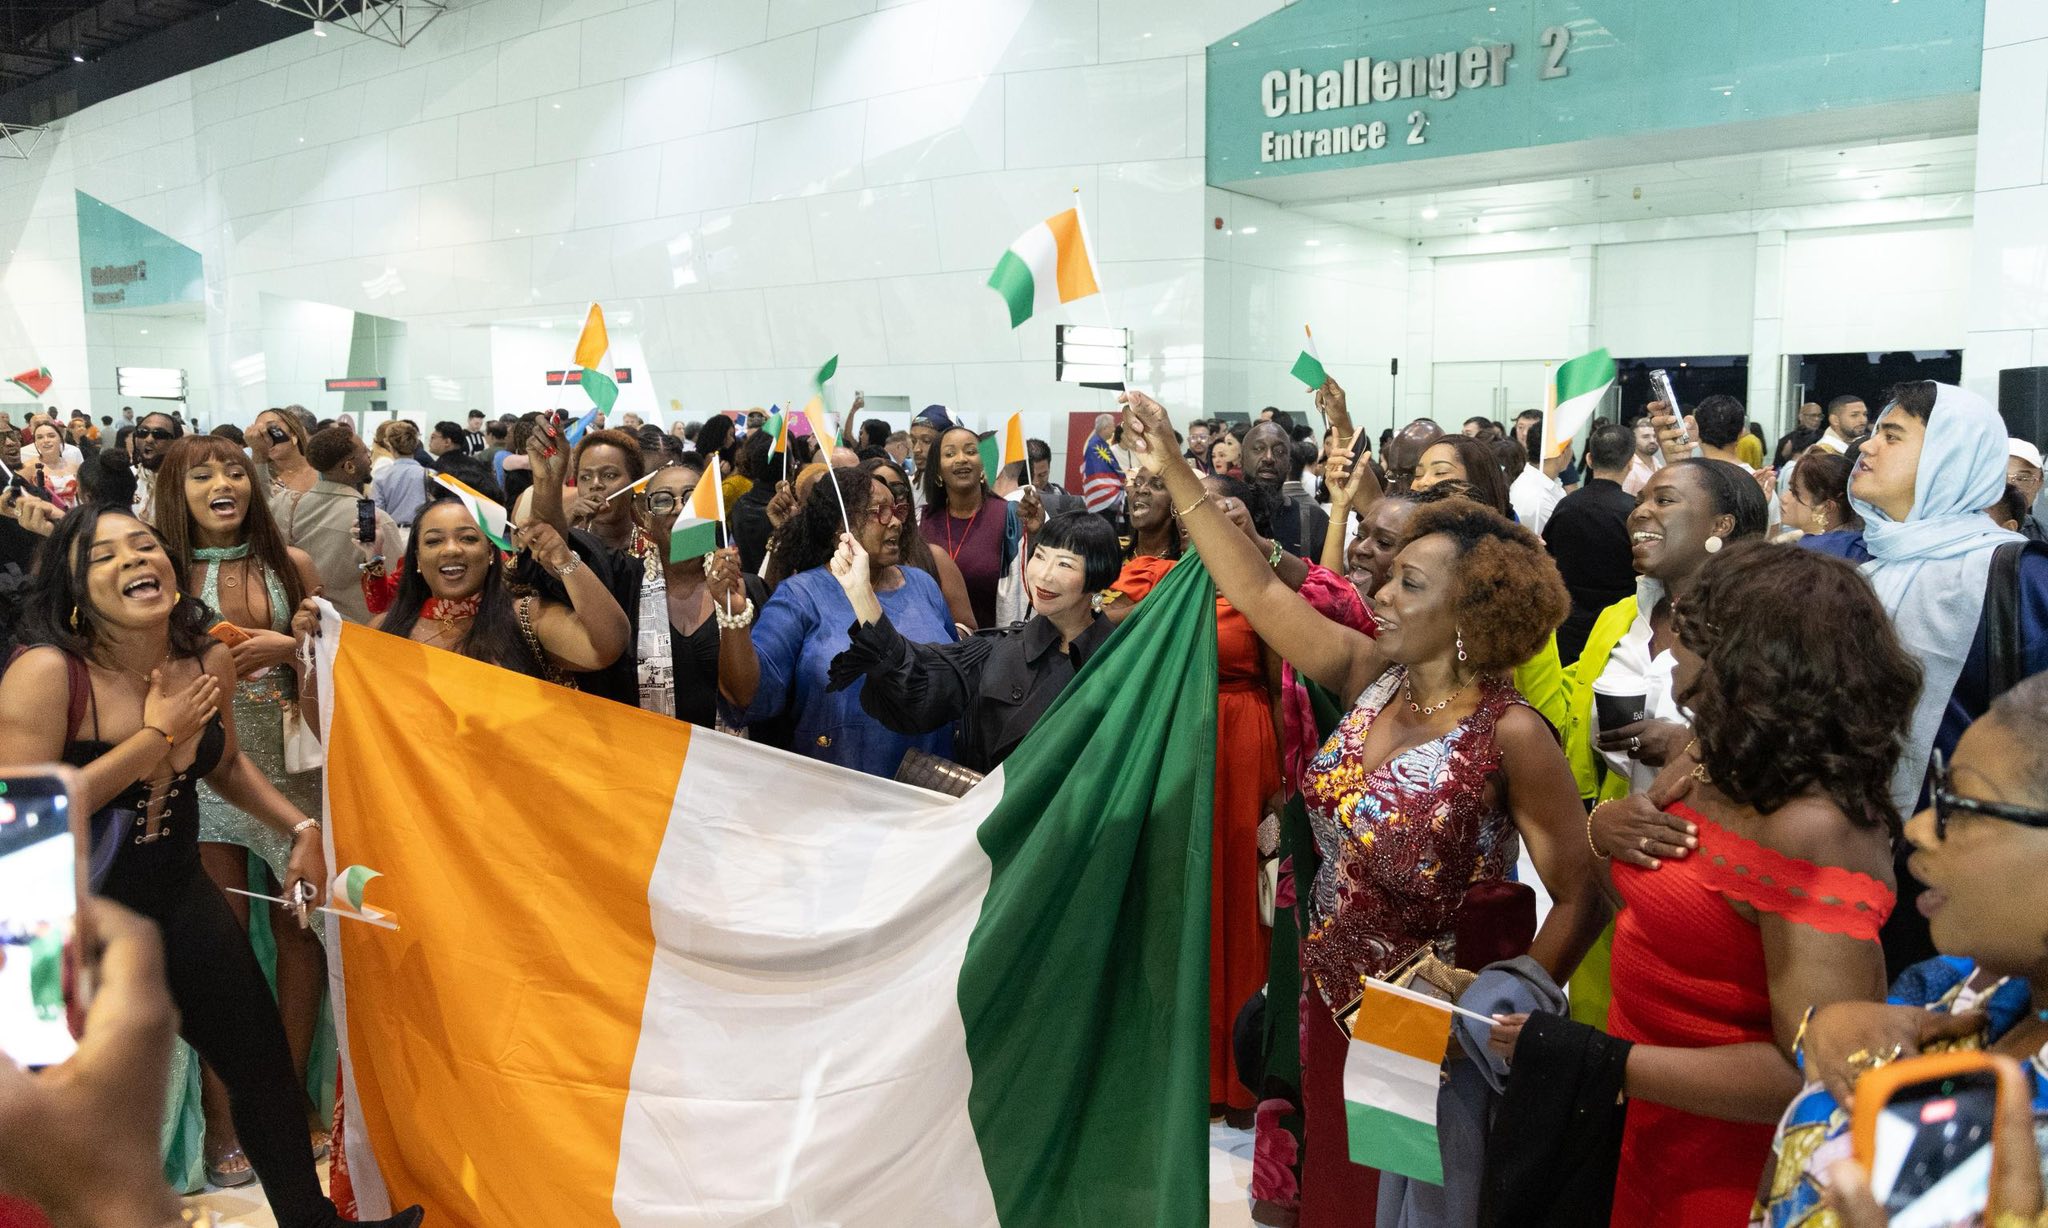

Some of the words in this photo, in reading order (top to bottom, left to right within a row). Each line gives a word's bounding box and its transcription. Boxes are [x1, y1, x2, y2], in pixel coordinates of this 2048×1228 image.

[1261, 43, 1514, 118] Challenger
[1540, 25, 1571, 80] 2
[1261, 120, 1387, 162] Entrance
[1407, 110, 1427, 145] 2
